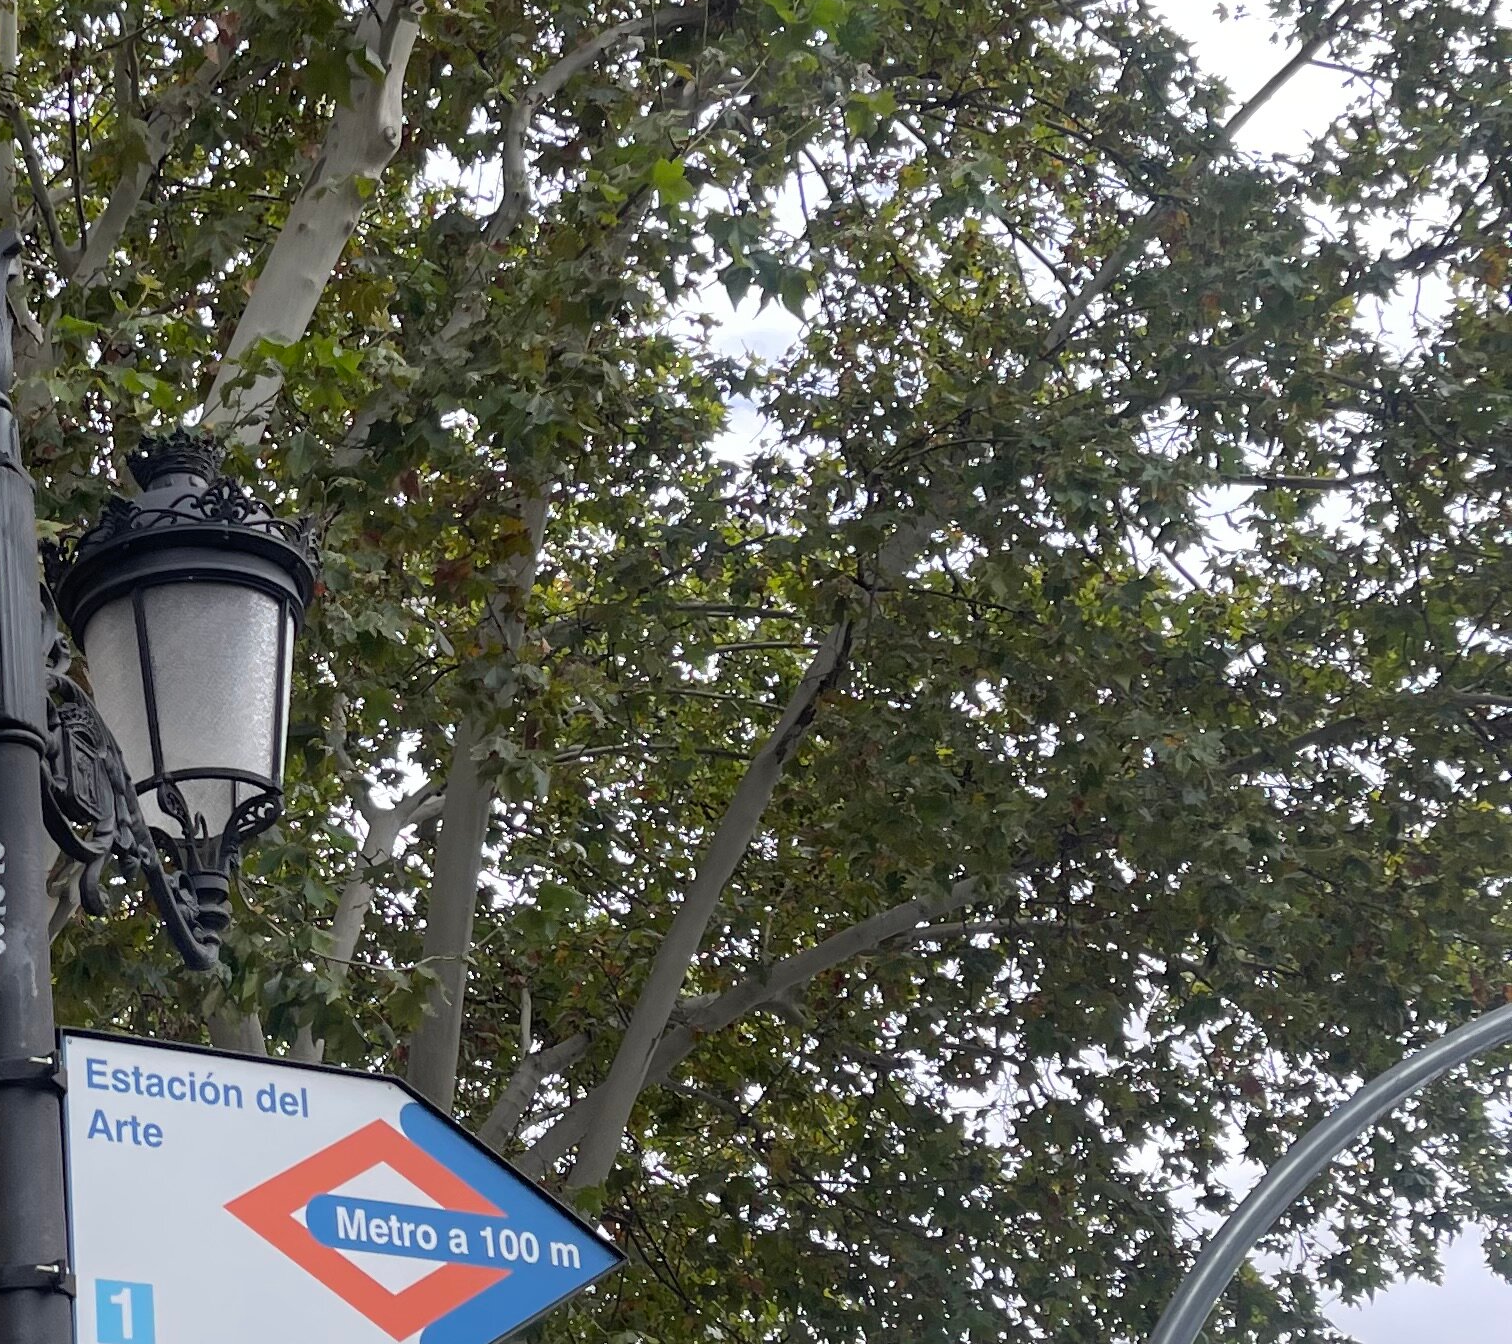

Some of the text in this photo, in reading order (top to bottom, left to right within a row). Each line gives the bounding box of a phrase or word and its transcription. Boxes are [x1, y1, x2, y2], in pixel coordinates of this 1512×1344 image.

[86, 1057, 309, 1119] Estación del
[87, 1108, 164, 1148] Arte
[335, 1206, 581, 1270] Metro a 100 m
[110, 1287, 133, 1340] 1
